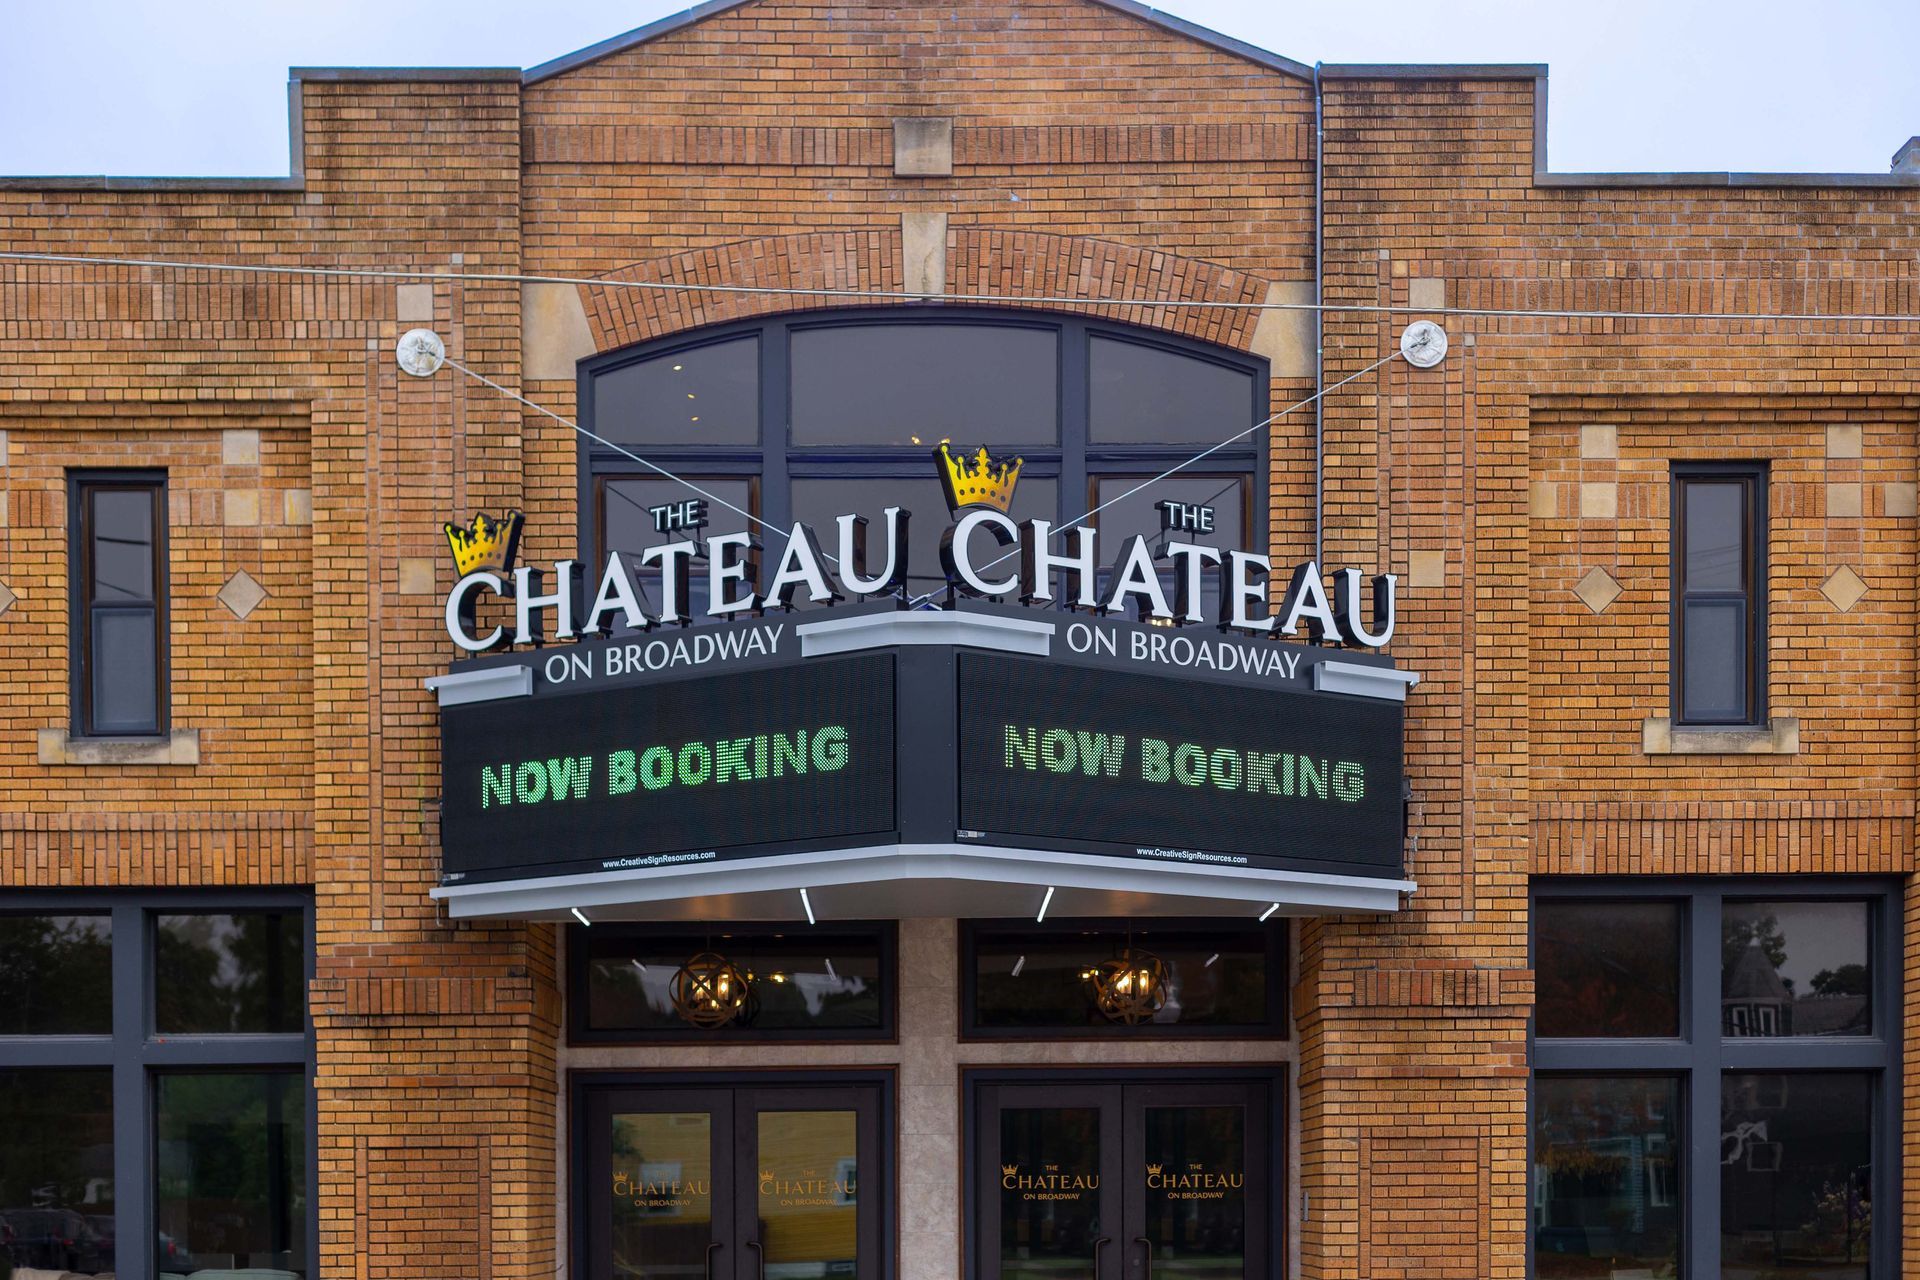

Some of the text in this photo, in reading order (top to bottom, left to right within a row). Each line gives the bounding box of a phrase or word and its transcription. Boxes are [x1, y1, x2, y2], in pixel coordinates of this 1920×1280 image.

[650, 500, 701, 530] THE
[1163, 501, 1214, 531] THE
[445, 506, 904, 651] CHATEAU
[951, 509, 1398, 647] CHATEAU
[544, 623, 784, 684] ON BROADWAY
[1066, 622, 1301, 680] ON BROADWAY
[481, 725, 849, 809] NOW BOOKING
[1004, 724, 1365, 802] NOW BOOKING
[602, 851, 716, 868] www.CreativeSignResources.com
[1136, 848, 1248, 864] www.CreativeSignResources.com
[803, 1169, 816, 1177] THE
[1045, 1164, 1059, 1172] THE
[1189, 1163, 1203, 1171] THE
[613, 1180, 711, 1196] CHATEAU
[759, 1179, 857, 1195] CHATEAU
[1002, 1174, 1100, 1190] CHATEAU
[1146, 1173, 1244, 1189] CHATEAU
[634, 1198, 691, 1207] ON BROADWAY
[780, 1199, 793, 1207] ON
[1023, 1192, 1080, 1201] ON BROADWAY
[1167, 1191, 1224, 1200] ON BROADWAY
